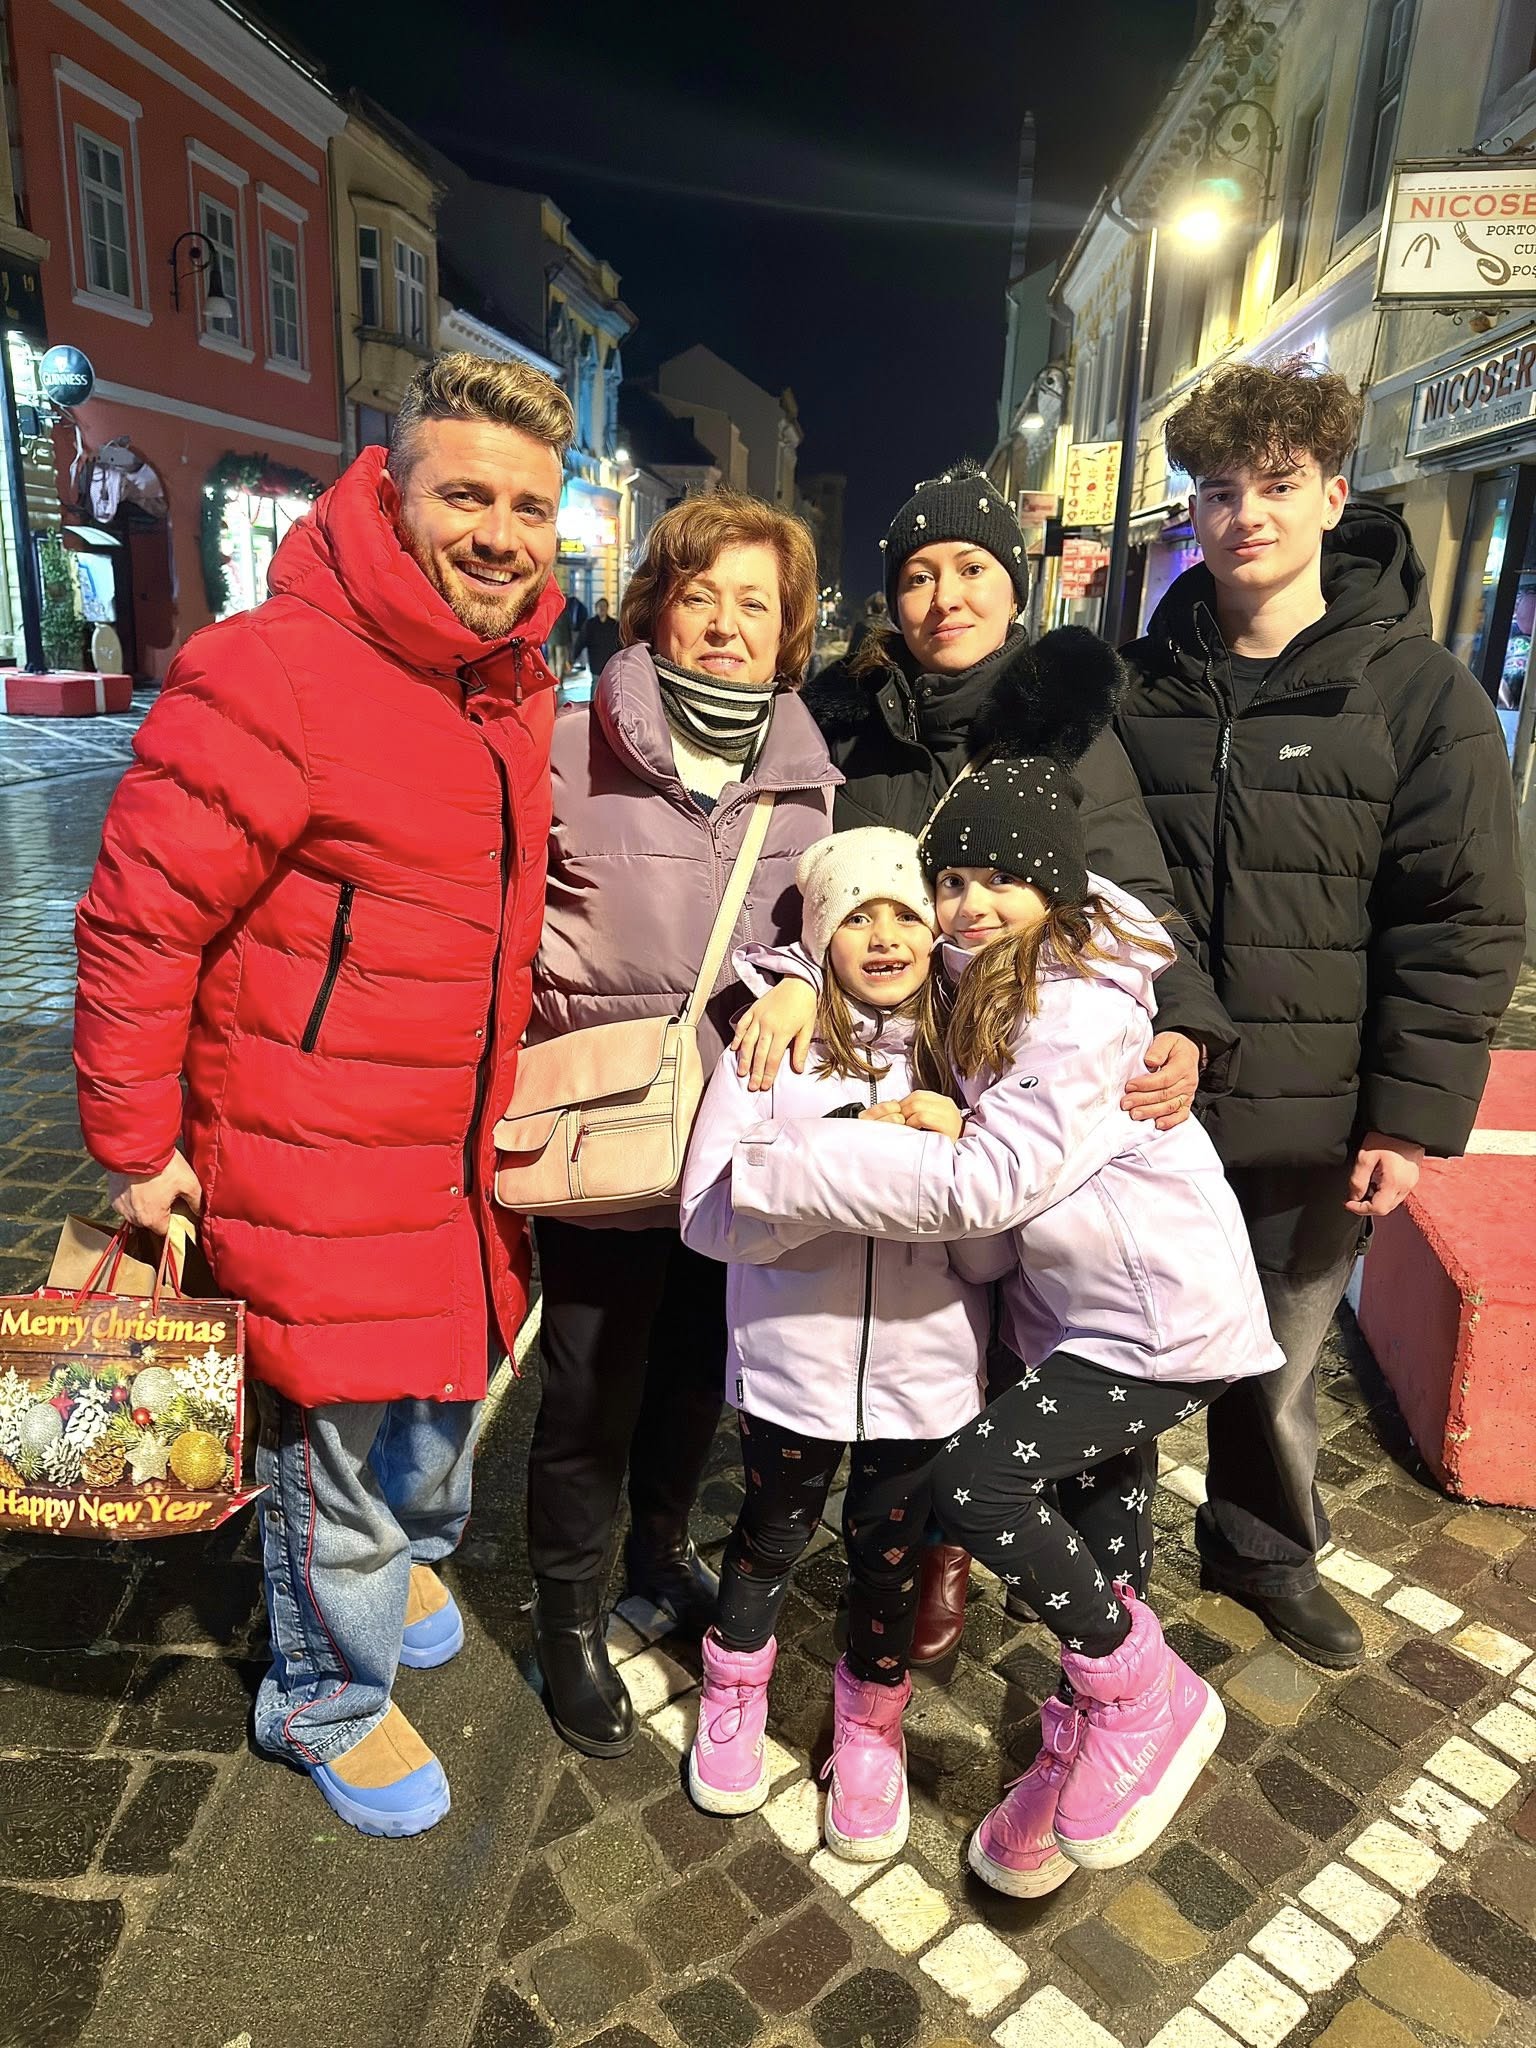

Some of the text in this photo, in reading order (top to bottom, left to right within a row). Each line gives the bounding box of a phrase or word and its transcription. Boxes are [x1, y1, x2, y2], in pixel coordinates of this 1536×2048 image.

[0, 1306, 226, 1347] Merry Christmas
[0, 1488, 213, 1529] Happy New Year
[1132, 1739, 1161, 1775] BOOT
